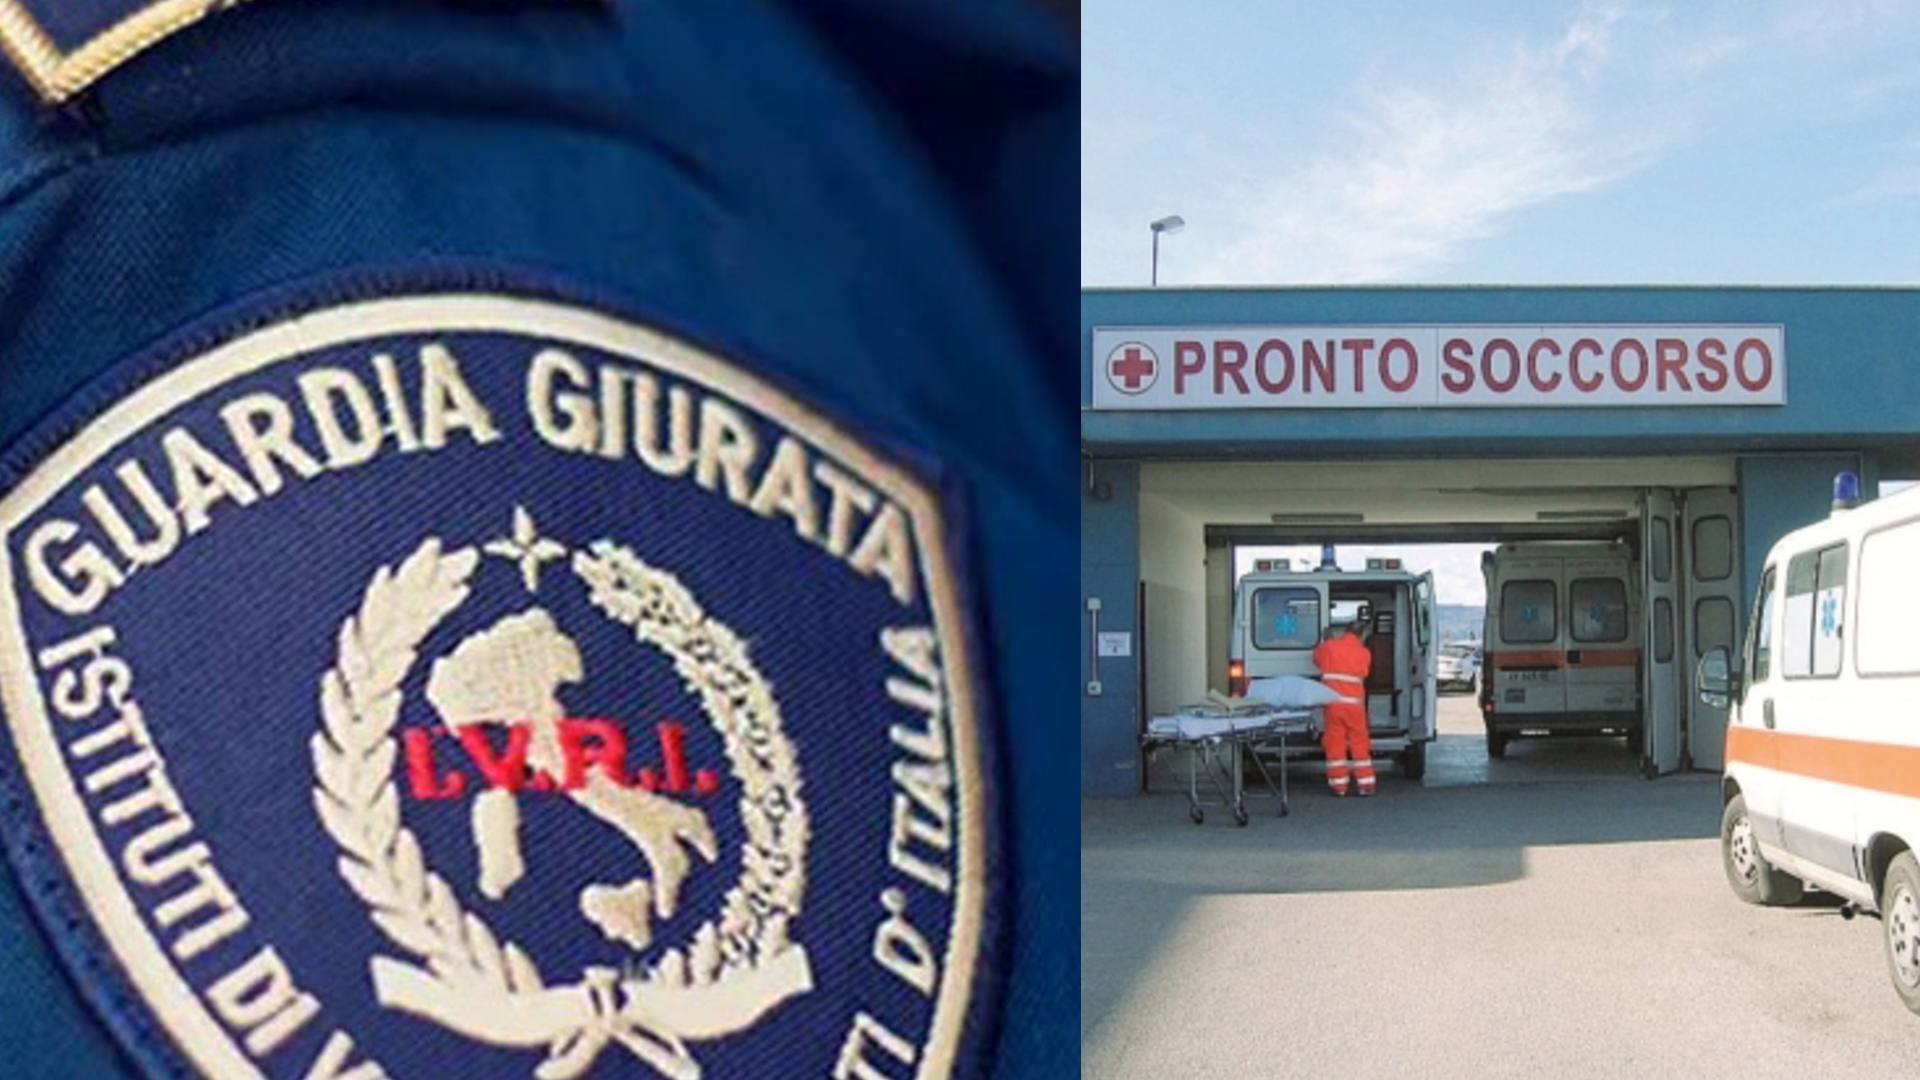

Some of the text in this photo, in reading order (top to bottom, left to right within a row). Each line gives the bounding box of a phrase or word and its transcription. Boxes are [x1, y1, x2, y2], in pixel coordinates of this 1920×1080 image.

[24, 343, 914, 615] GUARDIA GIURATA
[1173, 336, 1773, 394] PRONTO SOCCORSO
[38, 625, 250, 960] ISTITUTI
[205, 944, 322, 1057] DI
